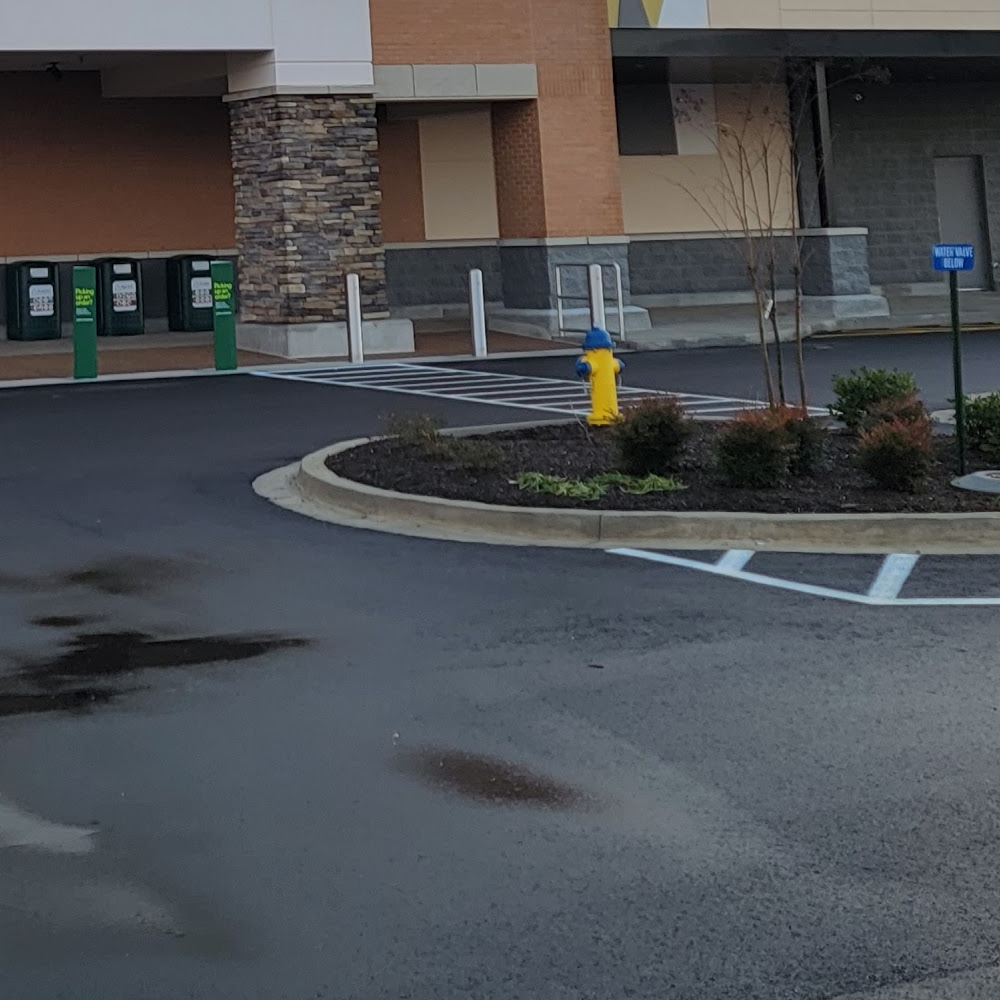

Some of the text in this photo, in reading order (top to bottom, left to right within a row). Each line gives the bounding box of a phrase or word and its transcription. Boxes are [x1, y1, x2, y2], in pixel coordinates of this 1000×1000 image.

[934, 246, 974, 257] WATER VALVE
[943, 258, 964, 268] BELOW
